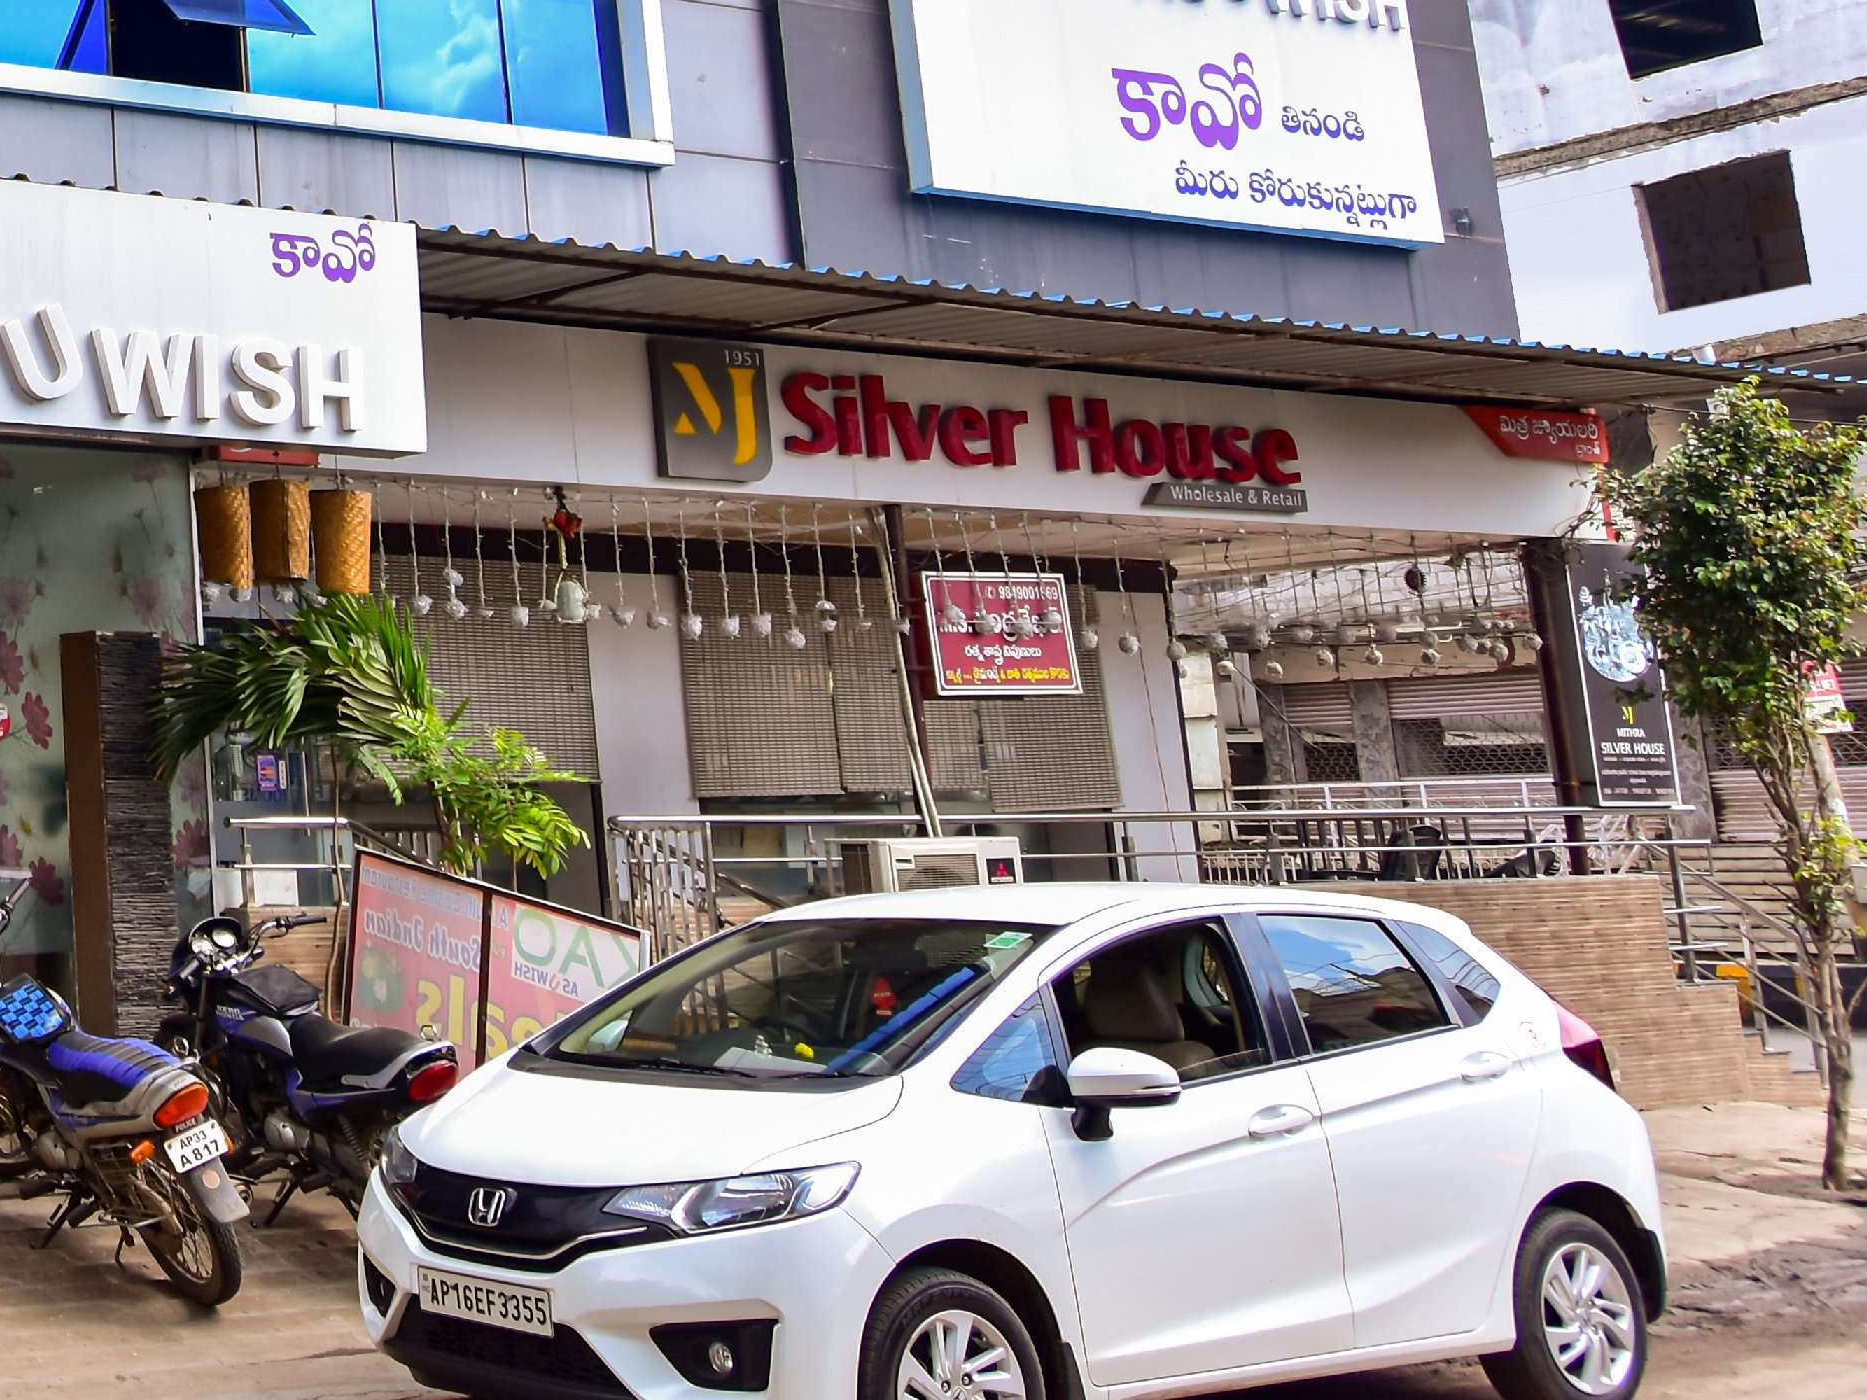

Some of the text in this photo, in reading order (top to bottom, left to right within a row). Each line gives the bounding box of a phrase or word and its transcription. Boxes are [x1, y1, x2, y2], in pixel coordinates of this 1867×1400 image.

[1112, 52, 1364, 150] కావో తినండి
[1175, 160, 1238, 198] మీరు
[269, 223, 375, 284] కావో
[724, 350, 760, 367] 1951
[780, 372, 1302, 484] Silver House
[1171, 486, 1303, 507] Wholesale & Retail
[1616, 728, 1646, 738] MITHRA
[1601, 742, 1666, 754] SILVER HOUSE
[175, 1117, 196, 1132] POLICE
[179, 1130, 207, 1151] AP33
[431, 1278, 547, 1325] AP16EF3355
